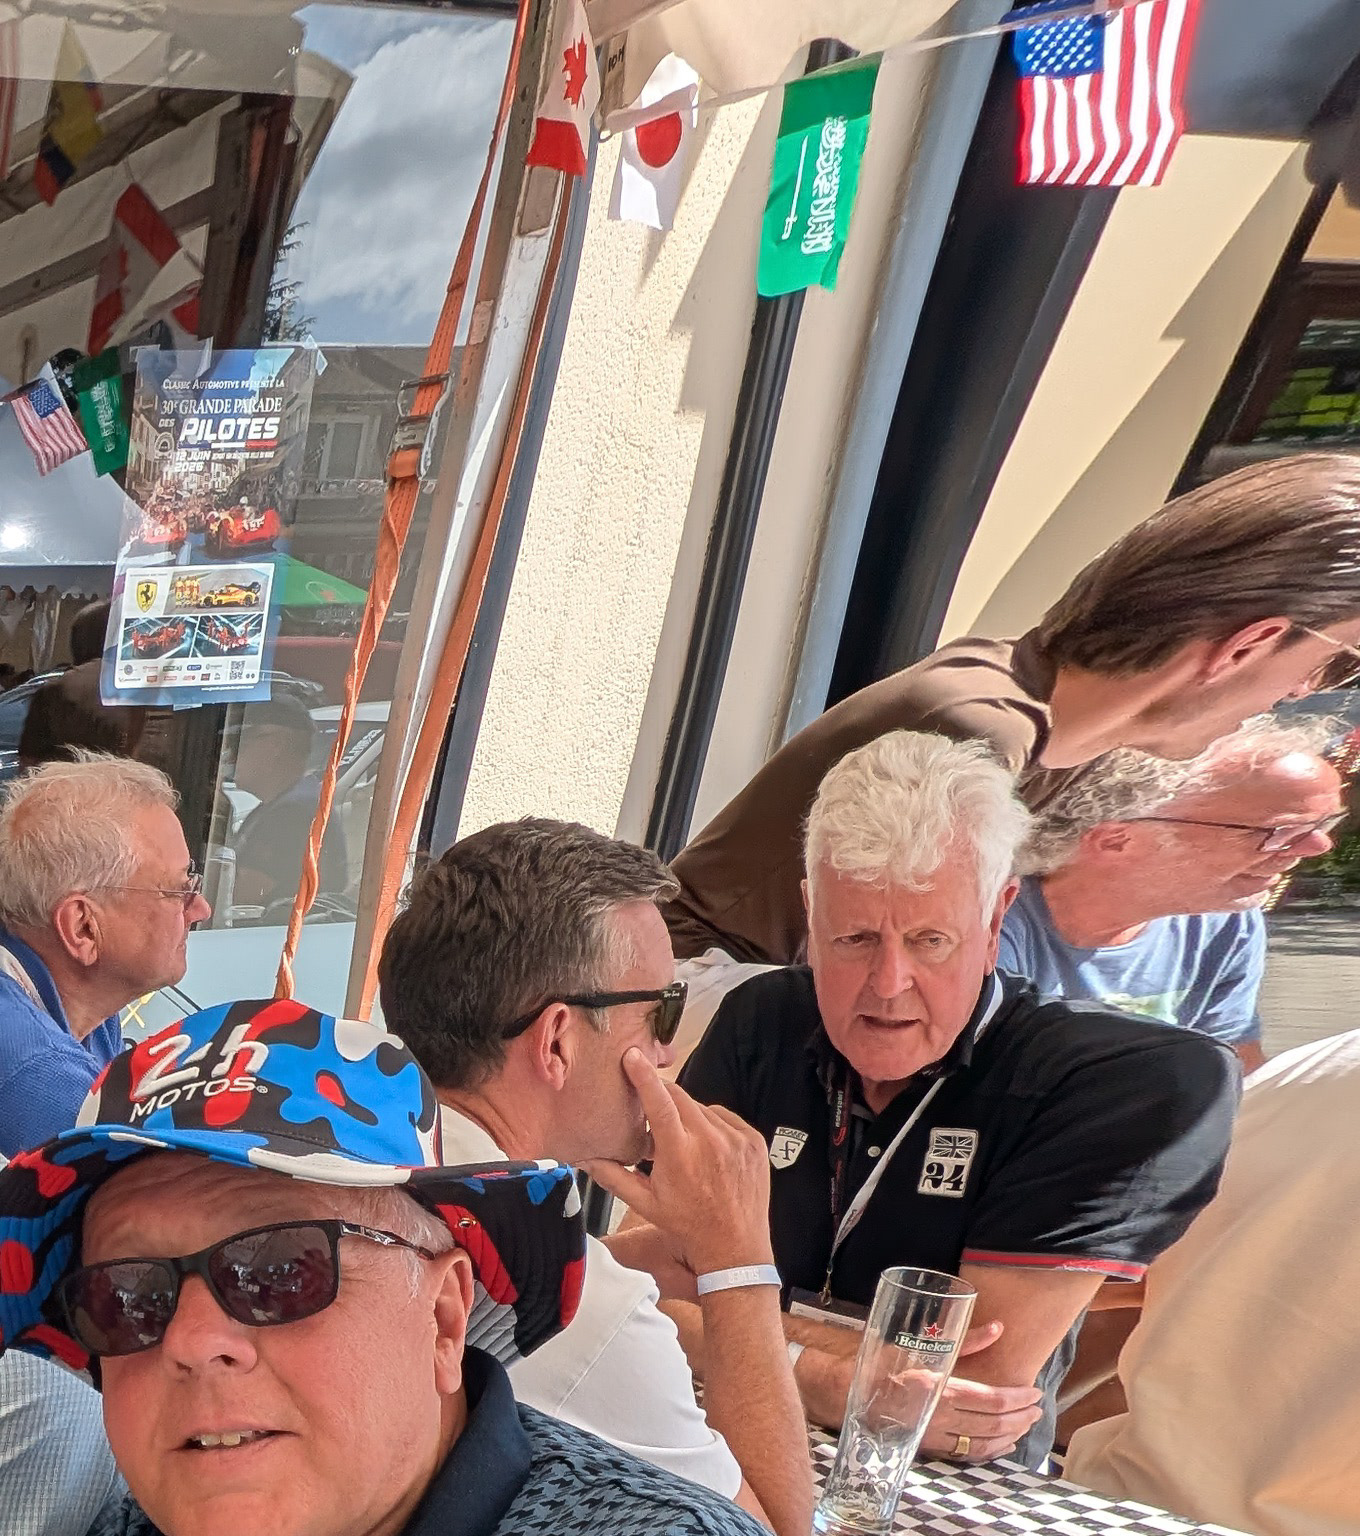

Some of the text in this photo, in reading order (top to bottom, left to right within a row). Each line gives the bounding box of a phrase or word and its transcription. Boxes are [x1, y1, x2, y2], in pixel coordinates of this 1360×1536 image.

[180, 398, 232, 415] GRANDE
[233, 397, 283, 415] PARADE
[159, 419, 175, 428] DES
[179, 417, 280, 441] PILOTES
[188, 450, 211, 461] JUIN
[130, 1076, 257, 1124] MOTOS
[922, 1160, 965, 1193] 24
[898, 1335, 953, 1353] Heineken
